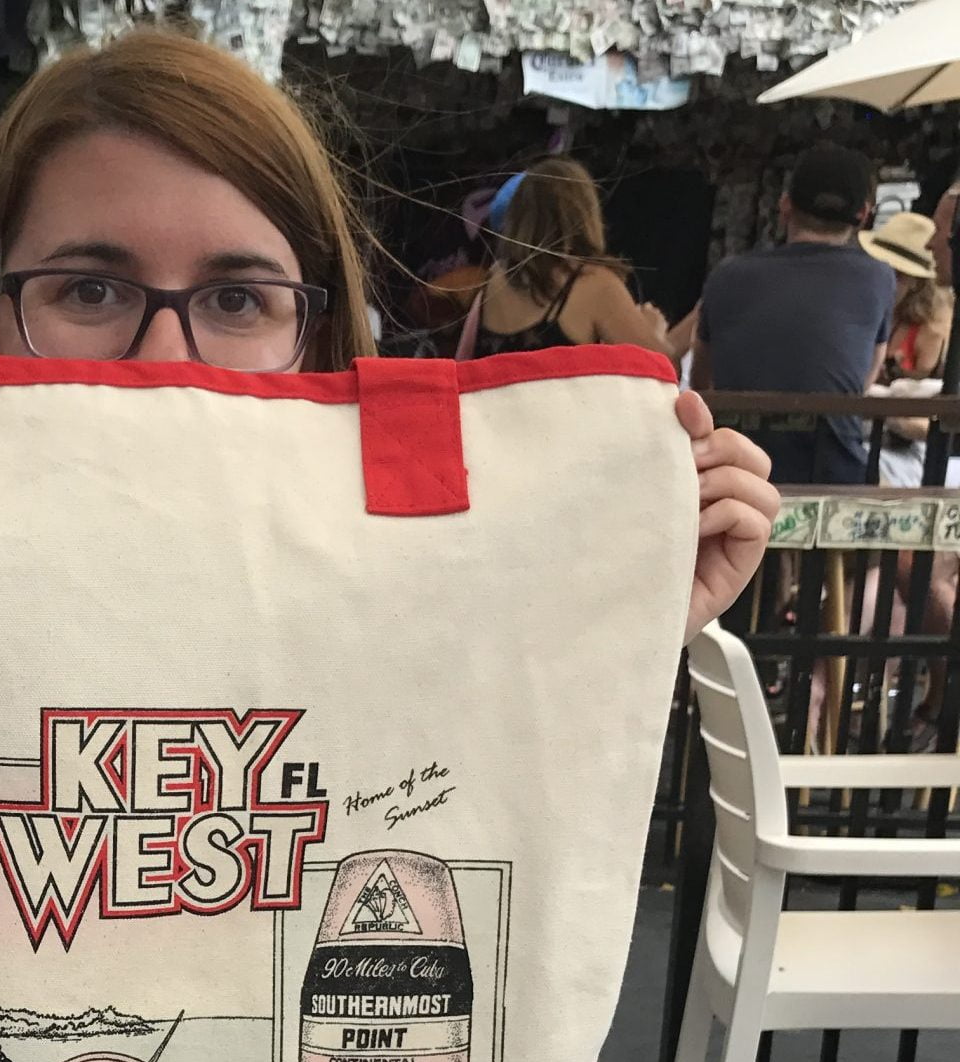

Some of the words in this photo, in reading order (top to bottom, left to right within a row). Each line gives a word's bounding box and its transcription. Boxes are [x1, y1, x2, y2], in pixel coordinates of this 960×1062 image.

[42, 709, 298, 813] KEY
[281, 762, 328, 799] FL
[343, 786, 394, 816] Home
[399, 769, 416, 797] of
[420, 762, 450, 782] the
[384, 786, 456, 830] Sunset
[389, 880, 409, 910] CONCH
[353, 921, 404, 932] REPUBLIC
[321, 957, 348, 979] 90
[346, 957, 396, 980] Miles
[311, 994, 452, 1017] SOUTHERNMOST
[341, 1028, 408, 1049] POINT
